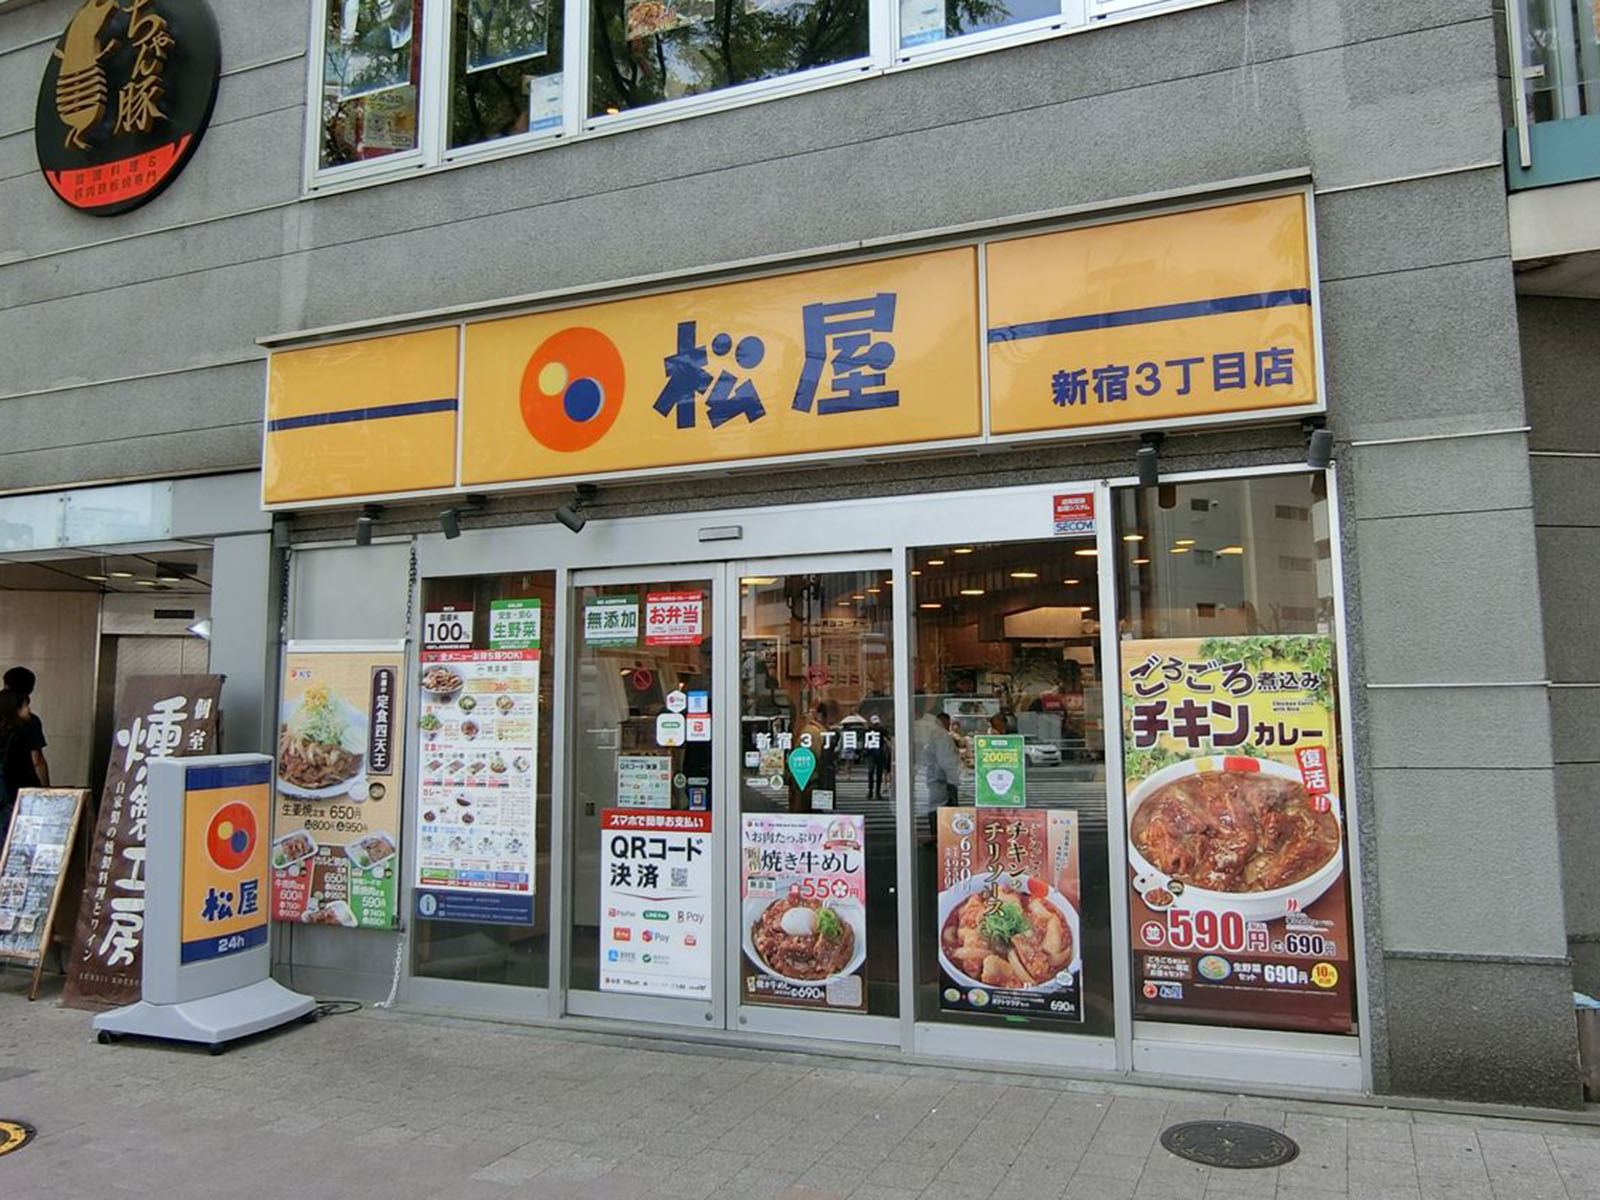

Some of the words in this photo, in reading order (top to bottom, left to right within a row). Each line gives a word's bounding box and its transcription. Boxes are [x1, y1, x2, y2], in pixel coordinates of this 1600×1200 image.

[653, 293, 900, 430] 松屋
[1051, 346, 1295, 407] 新宿3丁目店
[1056, 521, 1094, 532] SECOM
[587, 610, 636, 629] 無添加
[649, 605, 698, 624] お弁当
[493, 621, 536, 638] 生野菜
[1133, 699, 1323, 749] チキンカレー
[755, 730, 881, 750] 新宿3丁目店
[610, 814, 703, 828] スマホで簡単お支払い
[610, 835, 704, 862] QRコード
[761, 849, 860, 874] 焼き牛めし
[610, 863, 659, 889] 決済
[201, 879, 259, 922] 松屋
[218, 935, 245, 952] 24h
[1286, 934, 1336, 956] 690円
[1233, 963, 1261, 973] 生野菜
[1264, 965, 1308, 984] 690円
[1050, 1000, 1075, 1012] 690円
